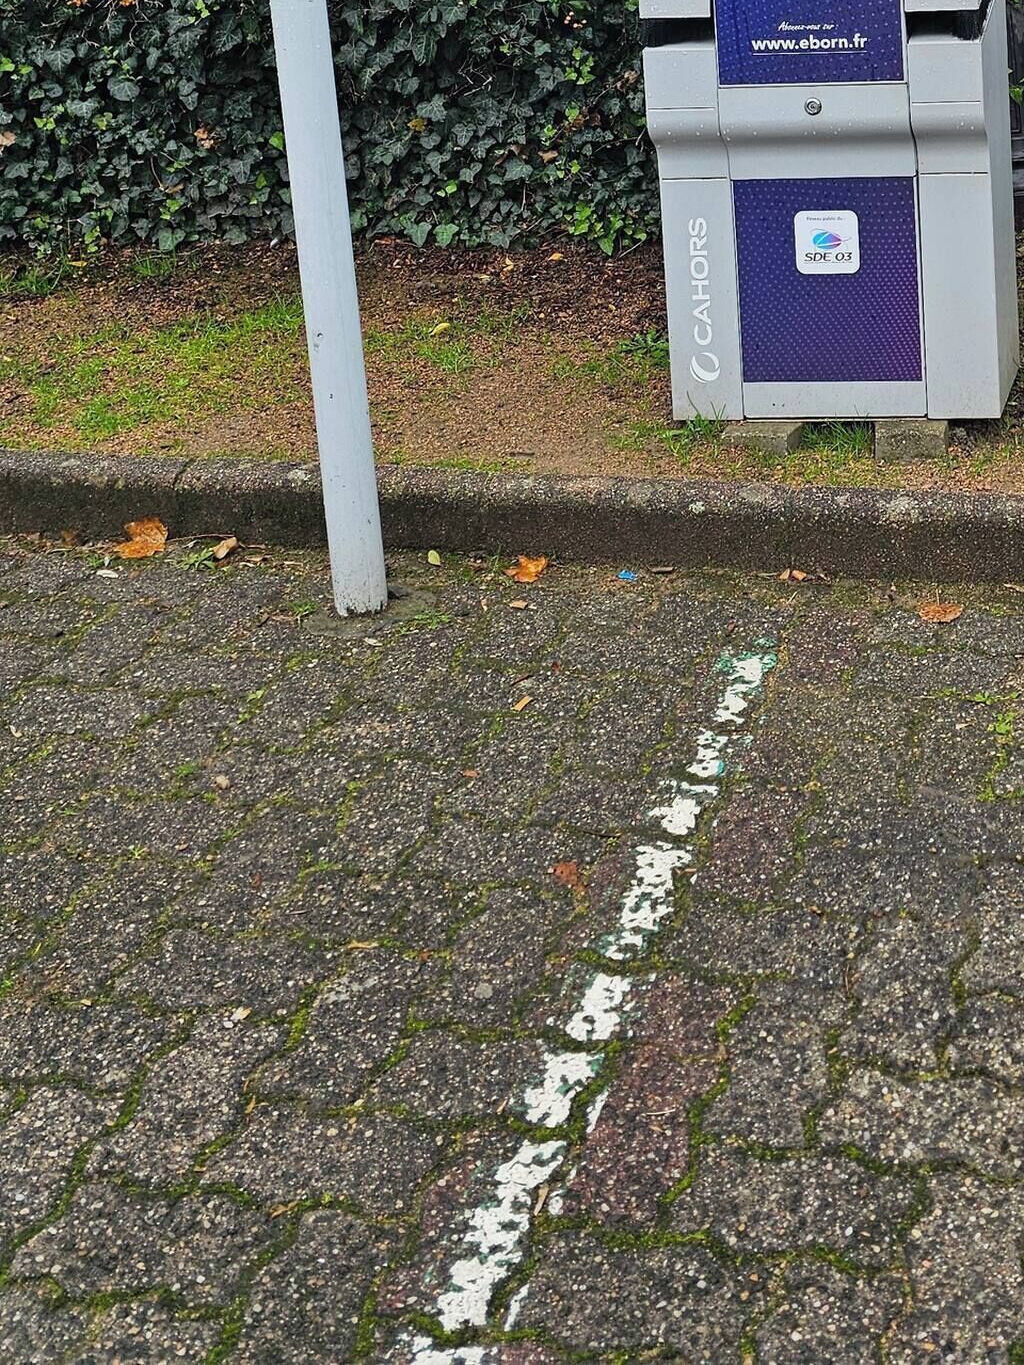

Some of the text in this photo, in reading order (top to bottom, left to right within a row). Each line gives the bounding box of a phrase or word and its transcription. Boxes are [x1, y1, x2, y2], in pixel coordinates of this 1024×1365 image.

[751, 33, 867, 51] www.eborn.fr
[804, 251, 853, 262] SDE 03
[688, 217, 713, 346] CAHORS
